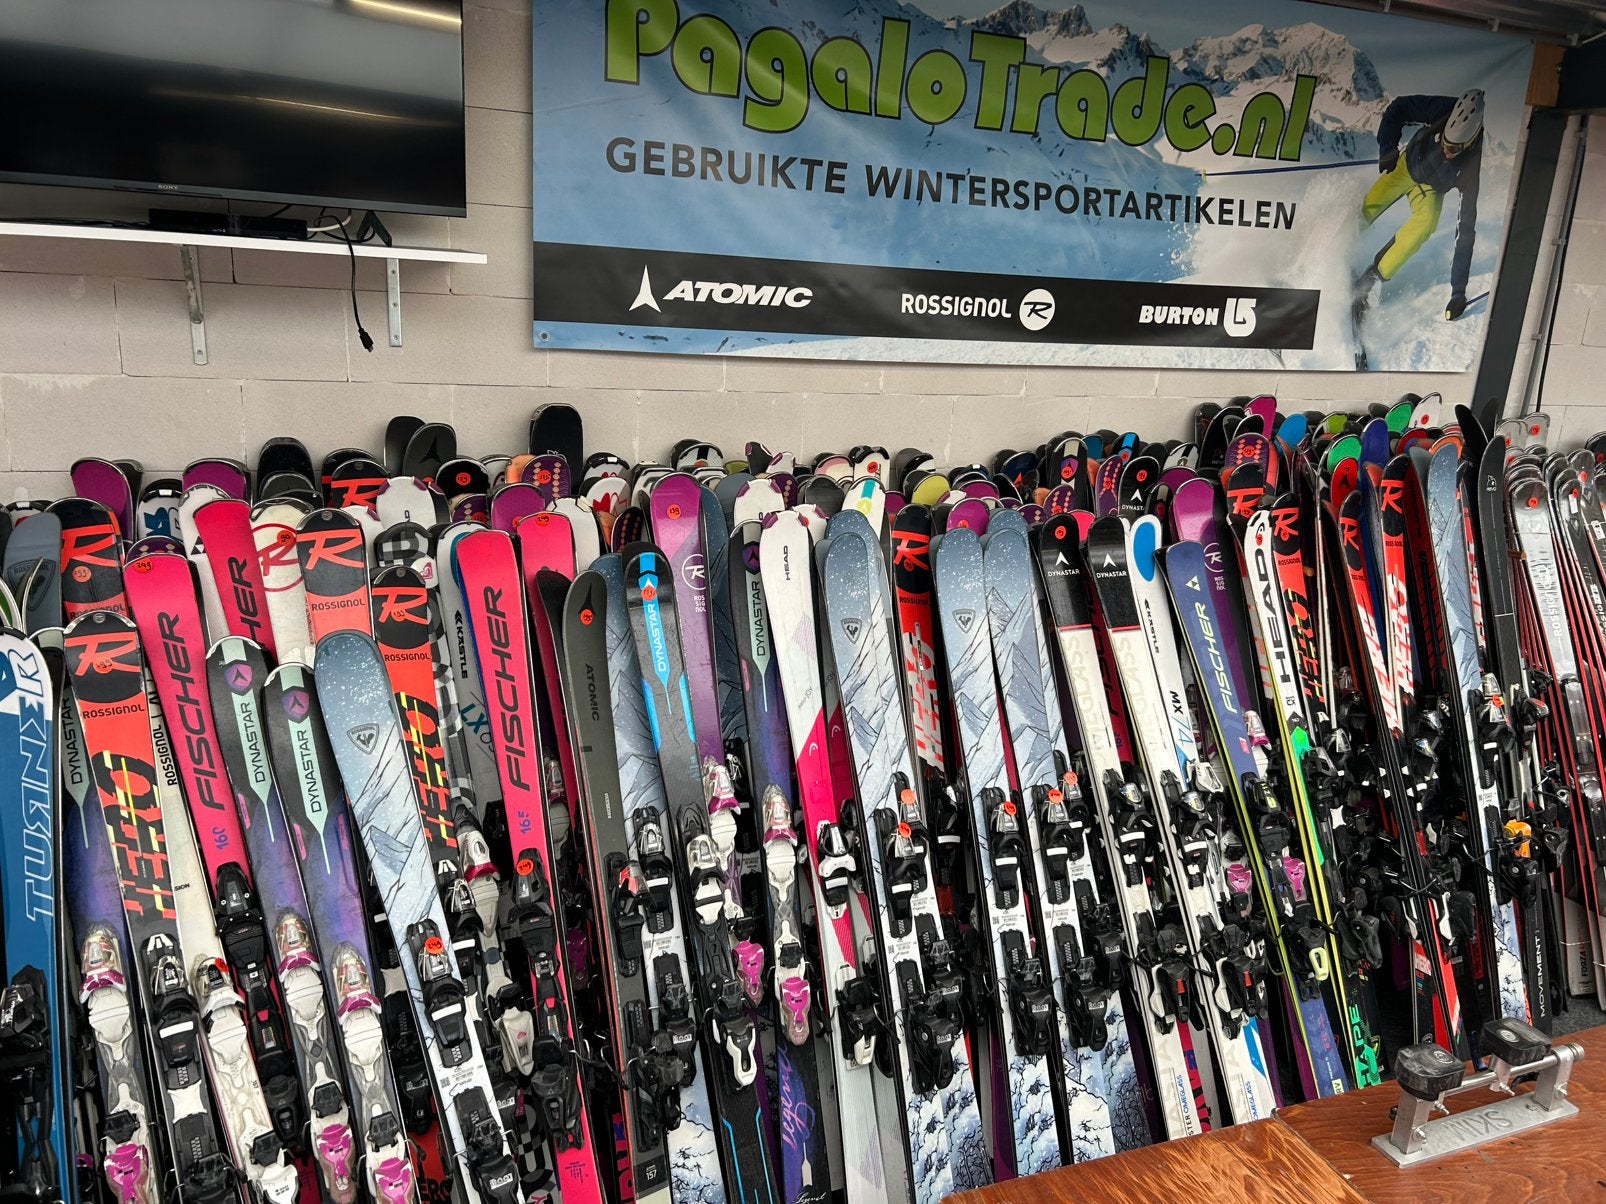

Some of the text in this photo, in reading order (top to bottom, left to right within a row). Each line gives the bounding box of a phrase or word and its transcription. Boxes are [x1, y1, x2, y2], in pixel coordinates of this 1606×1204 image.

[605, 0, 1318, 161] PagaloTrade.nl
[606, 136, 1297, 230] GEBRUIKTE WINTERSPORTARTIKELEN
[662, 280, 814, 308] ATOMIC
[901, 293, 1012, 320] ROSSIGNOL
[1139, 304, 1220, 326] BURTON
[783, 545, 791, 581] HEAD
[1047, 569, 1080, 577] DYNASTAR
[1096, 570, 1127, 579] DYNASTAR
[311, 598, 366, 611] ROSSIGNOL
[752, 580, 768, 657] DYNASTAR
[1255, 548, 1291, 684] HEAD
[384, 652, 431, 662] ROSSIGNOL
[647, 603, 667, 672] DYNASTAR
[1194, 602, 1238, 714] FISCHER
[82, 703, 145, 719] ROSSIGNOL
[157, 612, 226, 811] FISCHER
[483, 586, 530, 792] FISCHER
[585, 663, 600, 722] ATOMIC
[1169, 690, 1184, 715] MX
[152, 724, 178, 786] ROSSIGNOL
[242, 701, 266, 783] DYNASTAR
[296, 729, 322, 813] DYNASTAR
[1535, 935, 1546, 1018] MOVEMENT
[1579, 950, 1588, 977] FORZA
[1176, 1074, 1189, 1114] OMEGLASS
